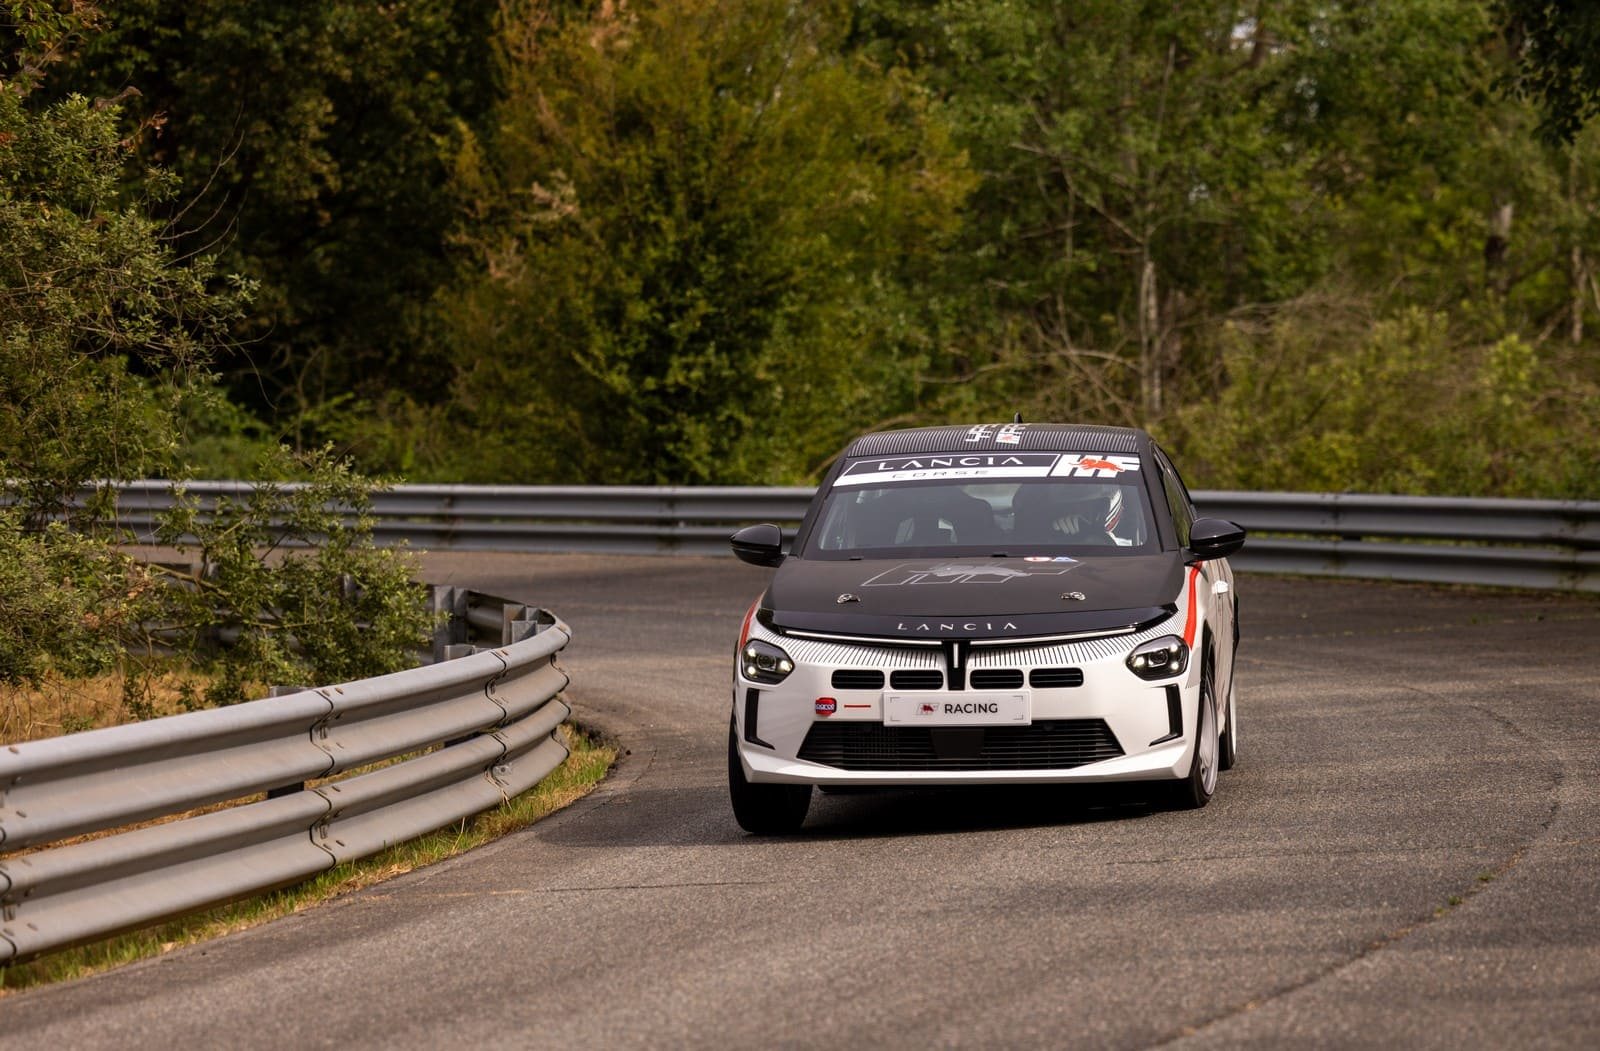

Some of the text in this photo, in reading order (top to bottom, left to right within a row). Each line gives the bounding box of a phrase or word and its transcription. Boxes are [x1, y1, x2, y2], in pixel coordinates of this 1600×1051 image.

[878, 456, 1024, 471] LANCIA
[892, 469, 989, 479] CORSE
[897, 622, 1017, 631] LANCIA
[944, 703, 998, 713] RACING
